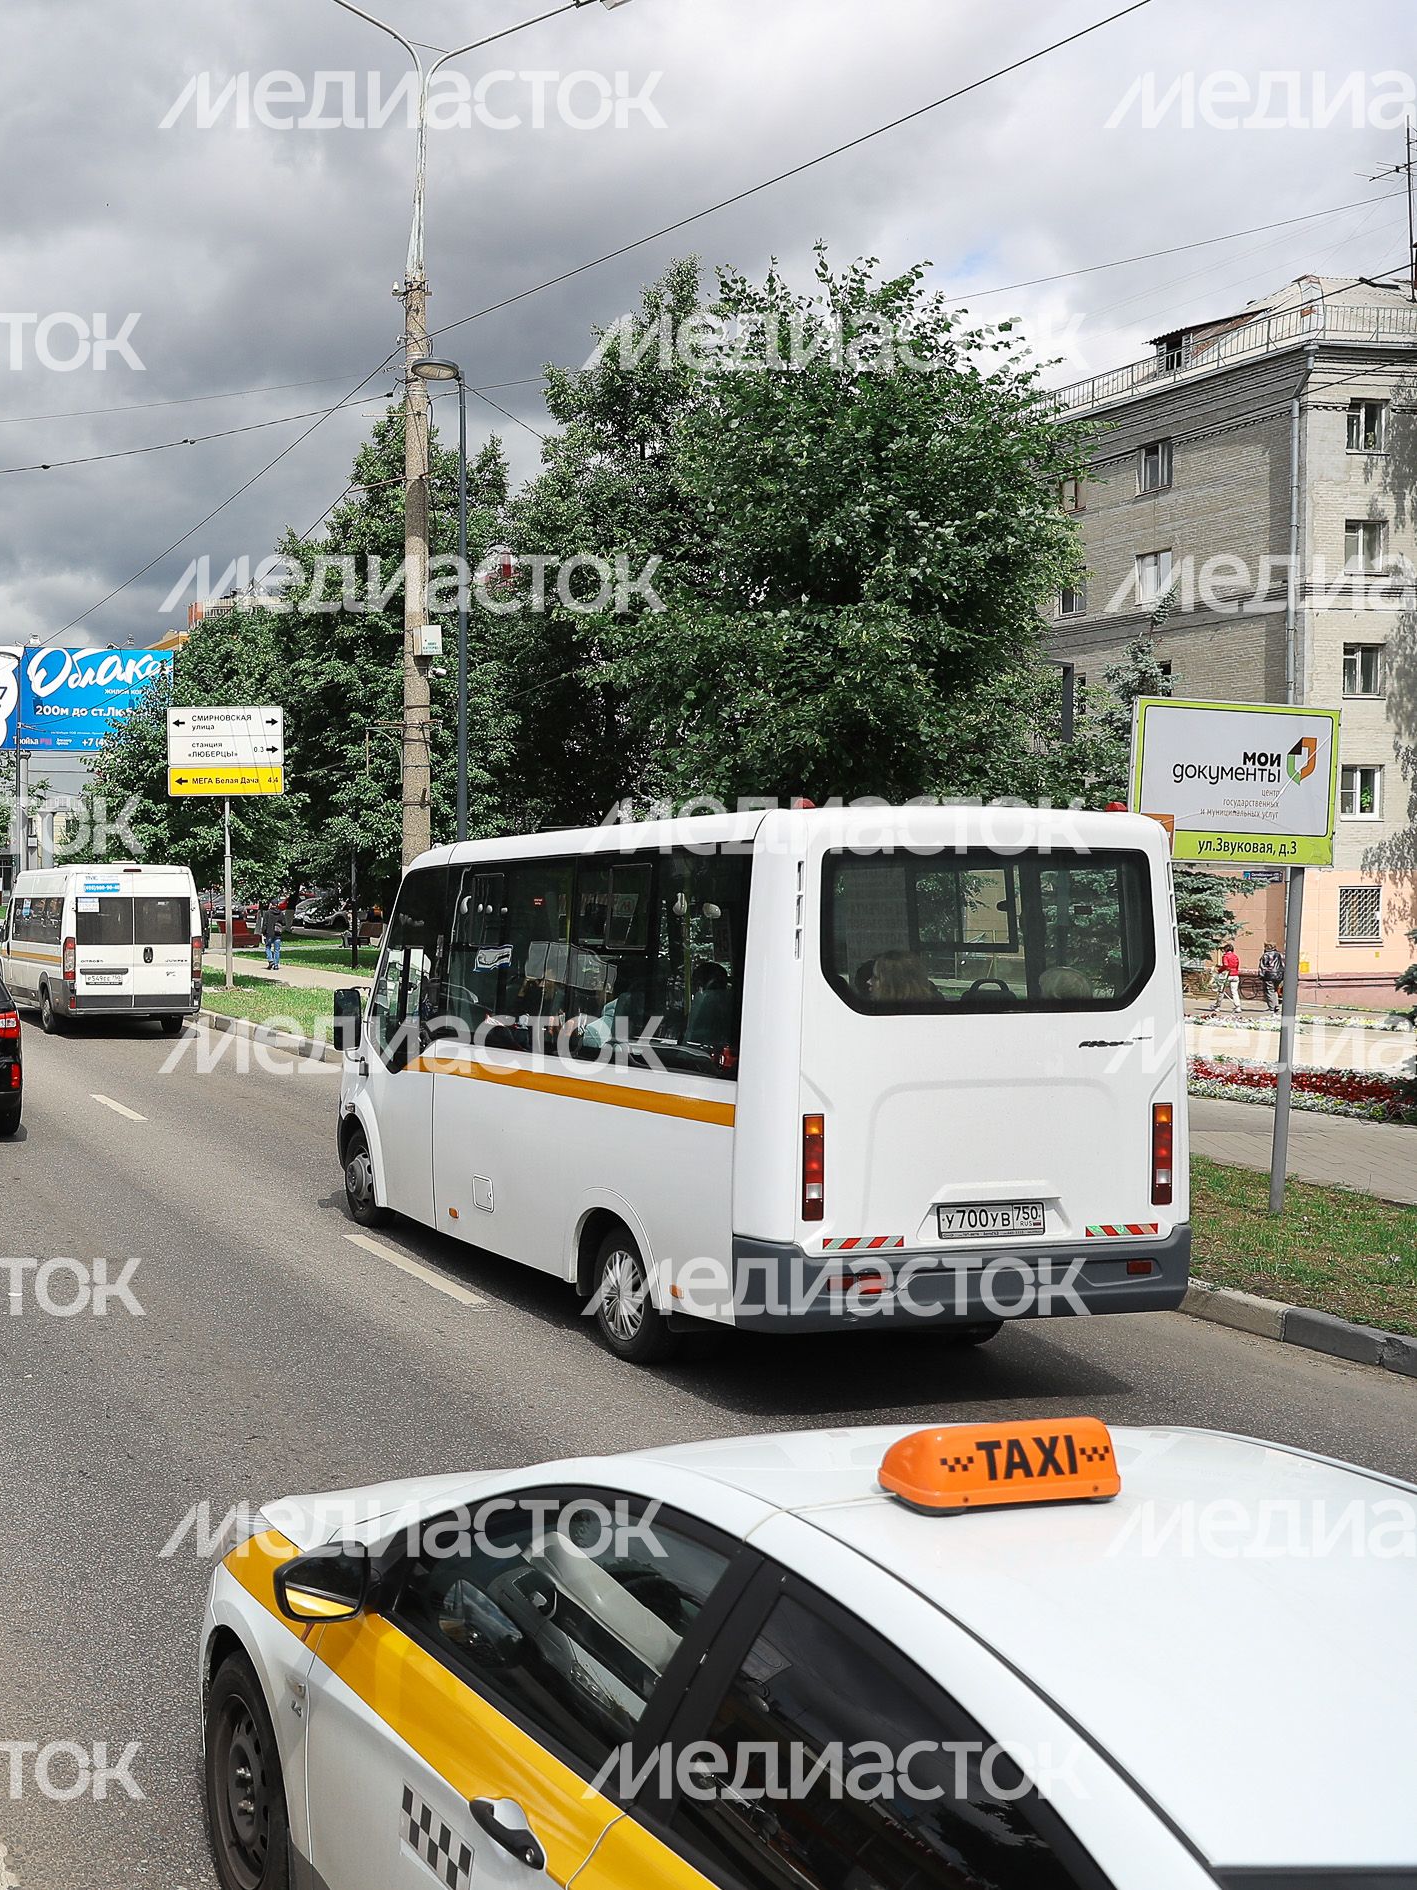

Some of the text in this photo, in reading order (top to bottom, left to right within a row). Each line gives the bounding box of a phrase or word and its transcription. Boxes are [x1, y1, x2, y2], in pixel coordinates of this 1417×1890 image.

[35, 705, 69, 716] 200м
[71, 707, 87, 718] до
[191, 714, 252, 722] СМИРНОВСКАЯ
[82, 738, 93, 747] +7
[1242, 752, 1281, 767] мои
[1172, 763, 1281, 785] документы
[1262, 788, 1280, 797] центр
[1223, 798, 1279, 809] государственных
[1207, 808, 1260, 818] муниципальных
[1262, 811, 1279, 820] услуг
[1197, 837, 1297, 857] ул.Звуковая, д.3
[945, 1205, 1039, 1229] У700УВ 750
[975, 1434, 1079, 1482] TAXI
